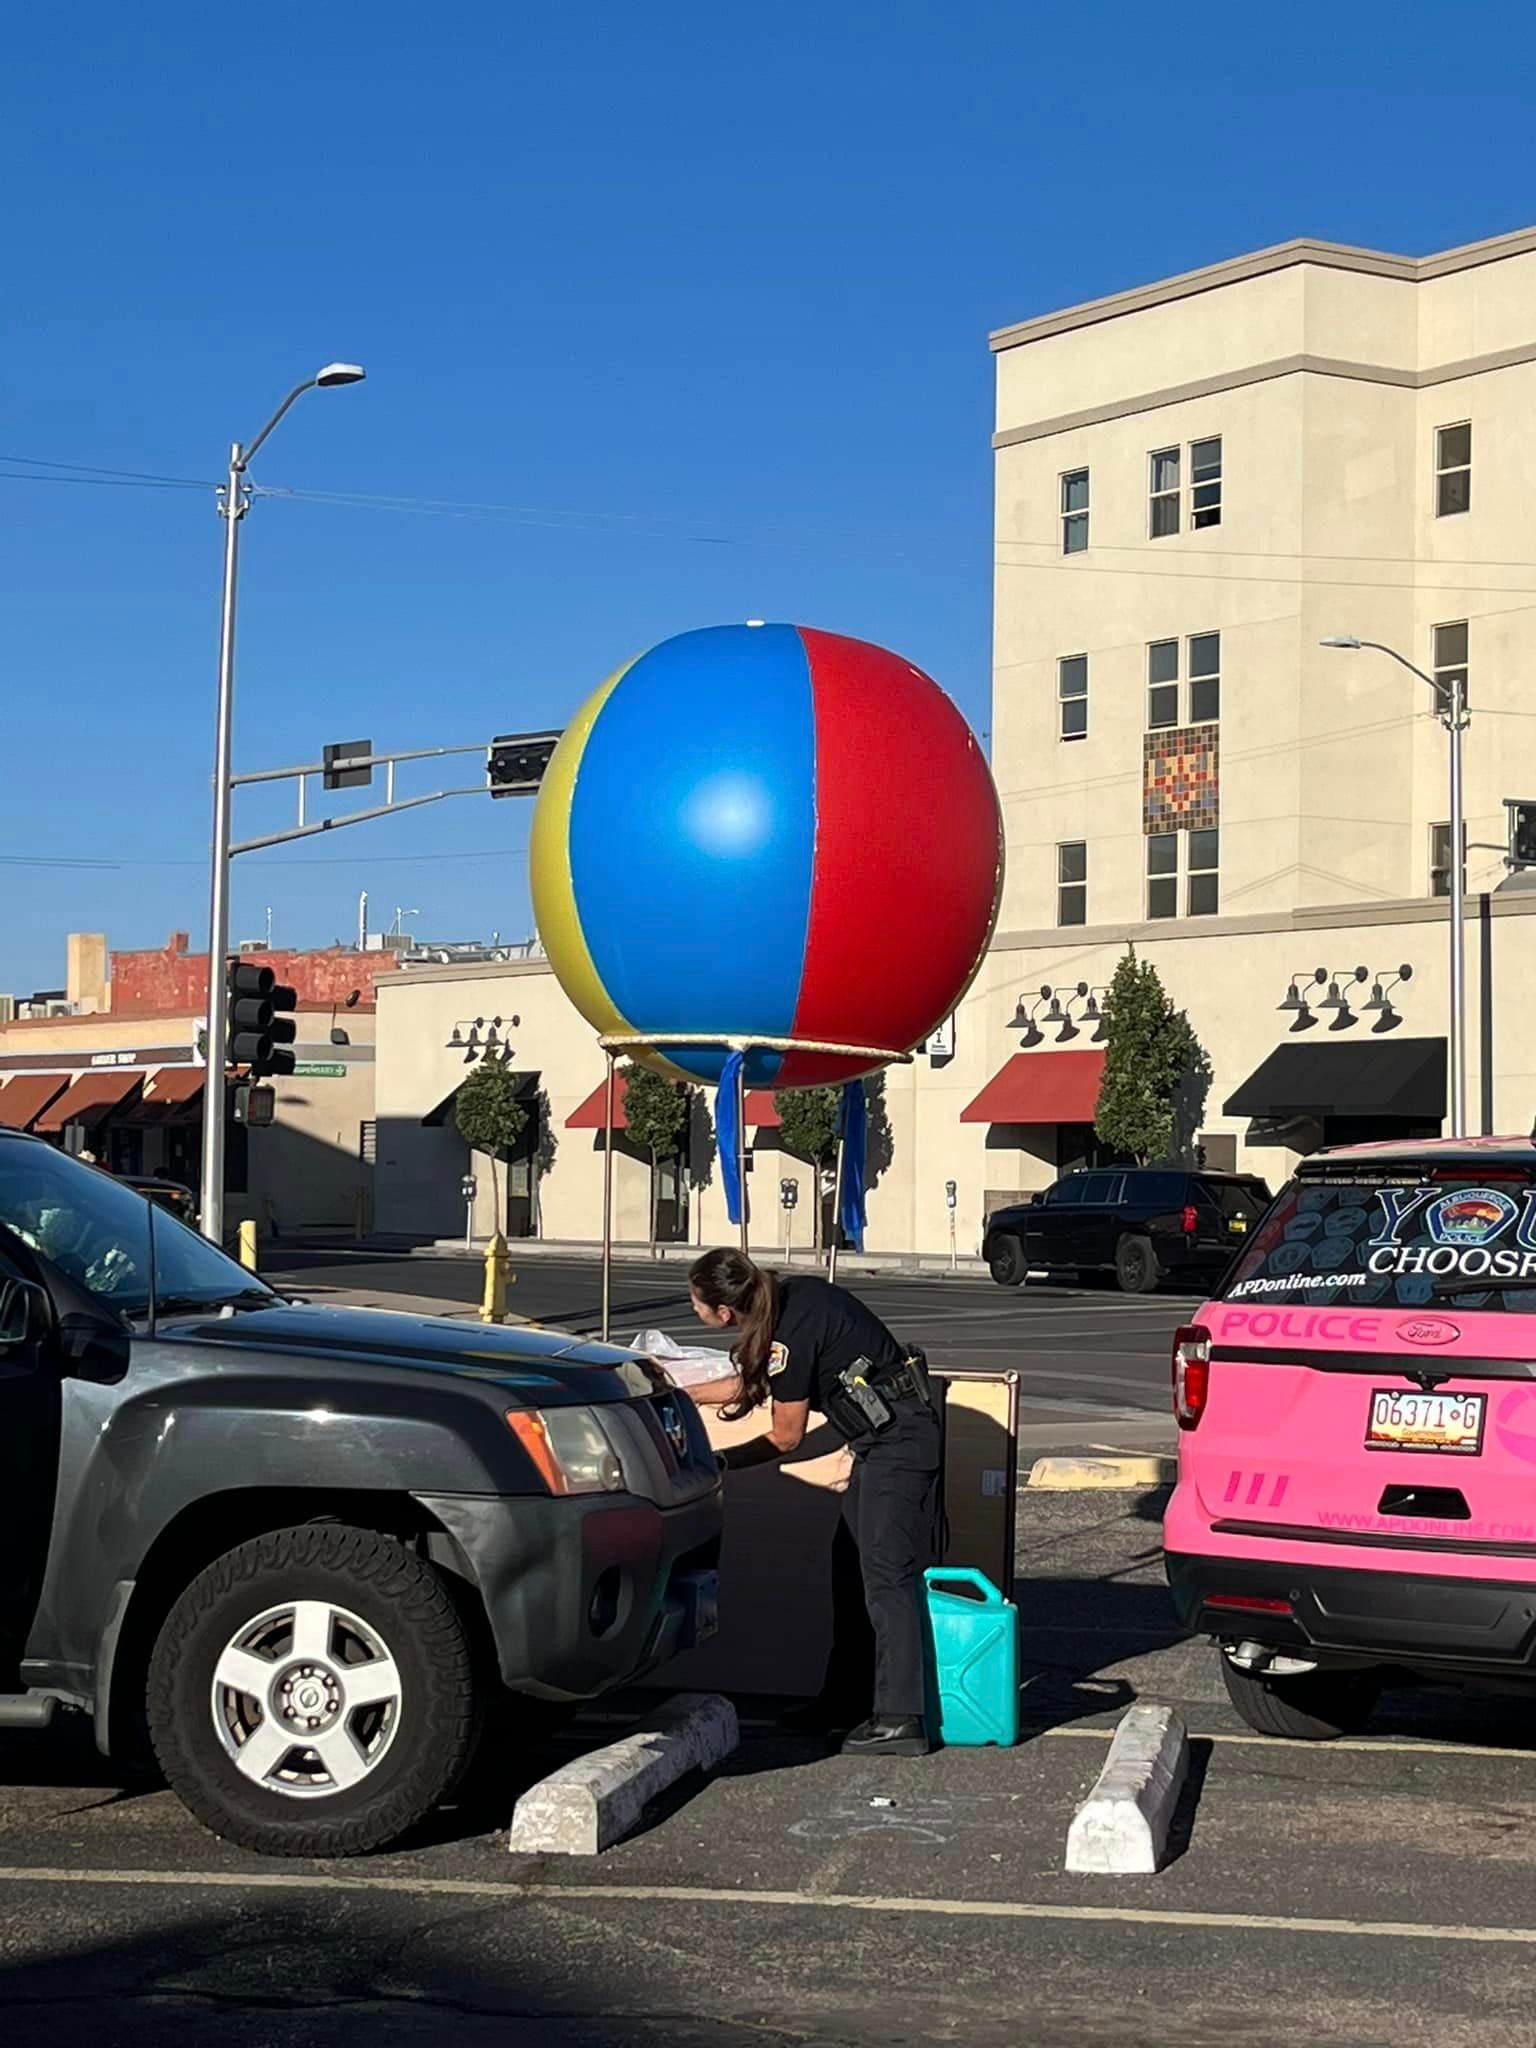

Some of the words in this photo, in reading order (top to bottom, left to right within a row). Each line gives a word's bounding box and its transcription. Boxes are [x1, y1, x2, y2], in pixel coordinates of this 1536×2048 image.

[1227, 1272, 1367, 1298] APDonline.com
[1220, 1311, 1382, 1343] POLICE
[1407, 1321, 1444, 1340] Ford
